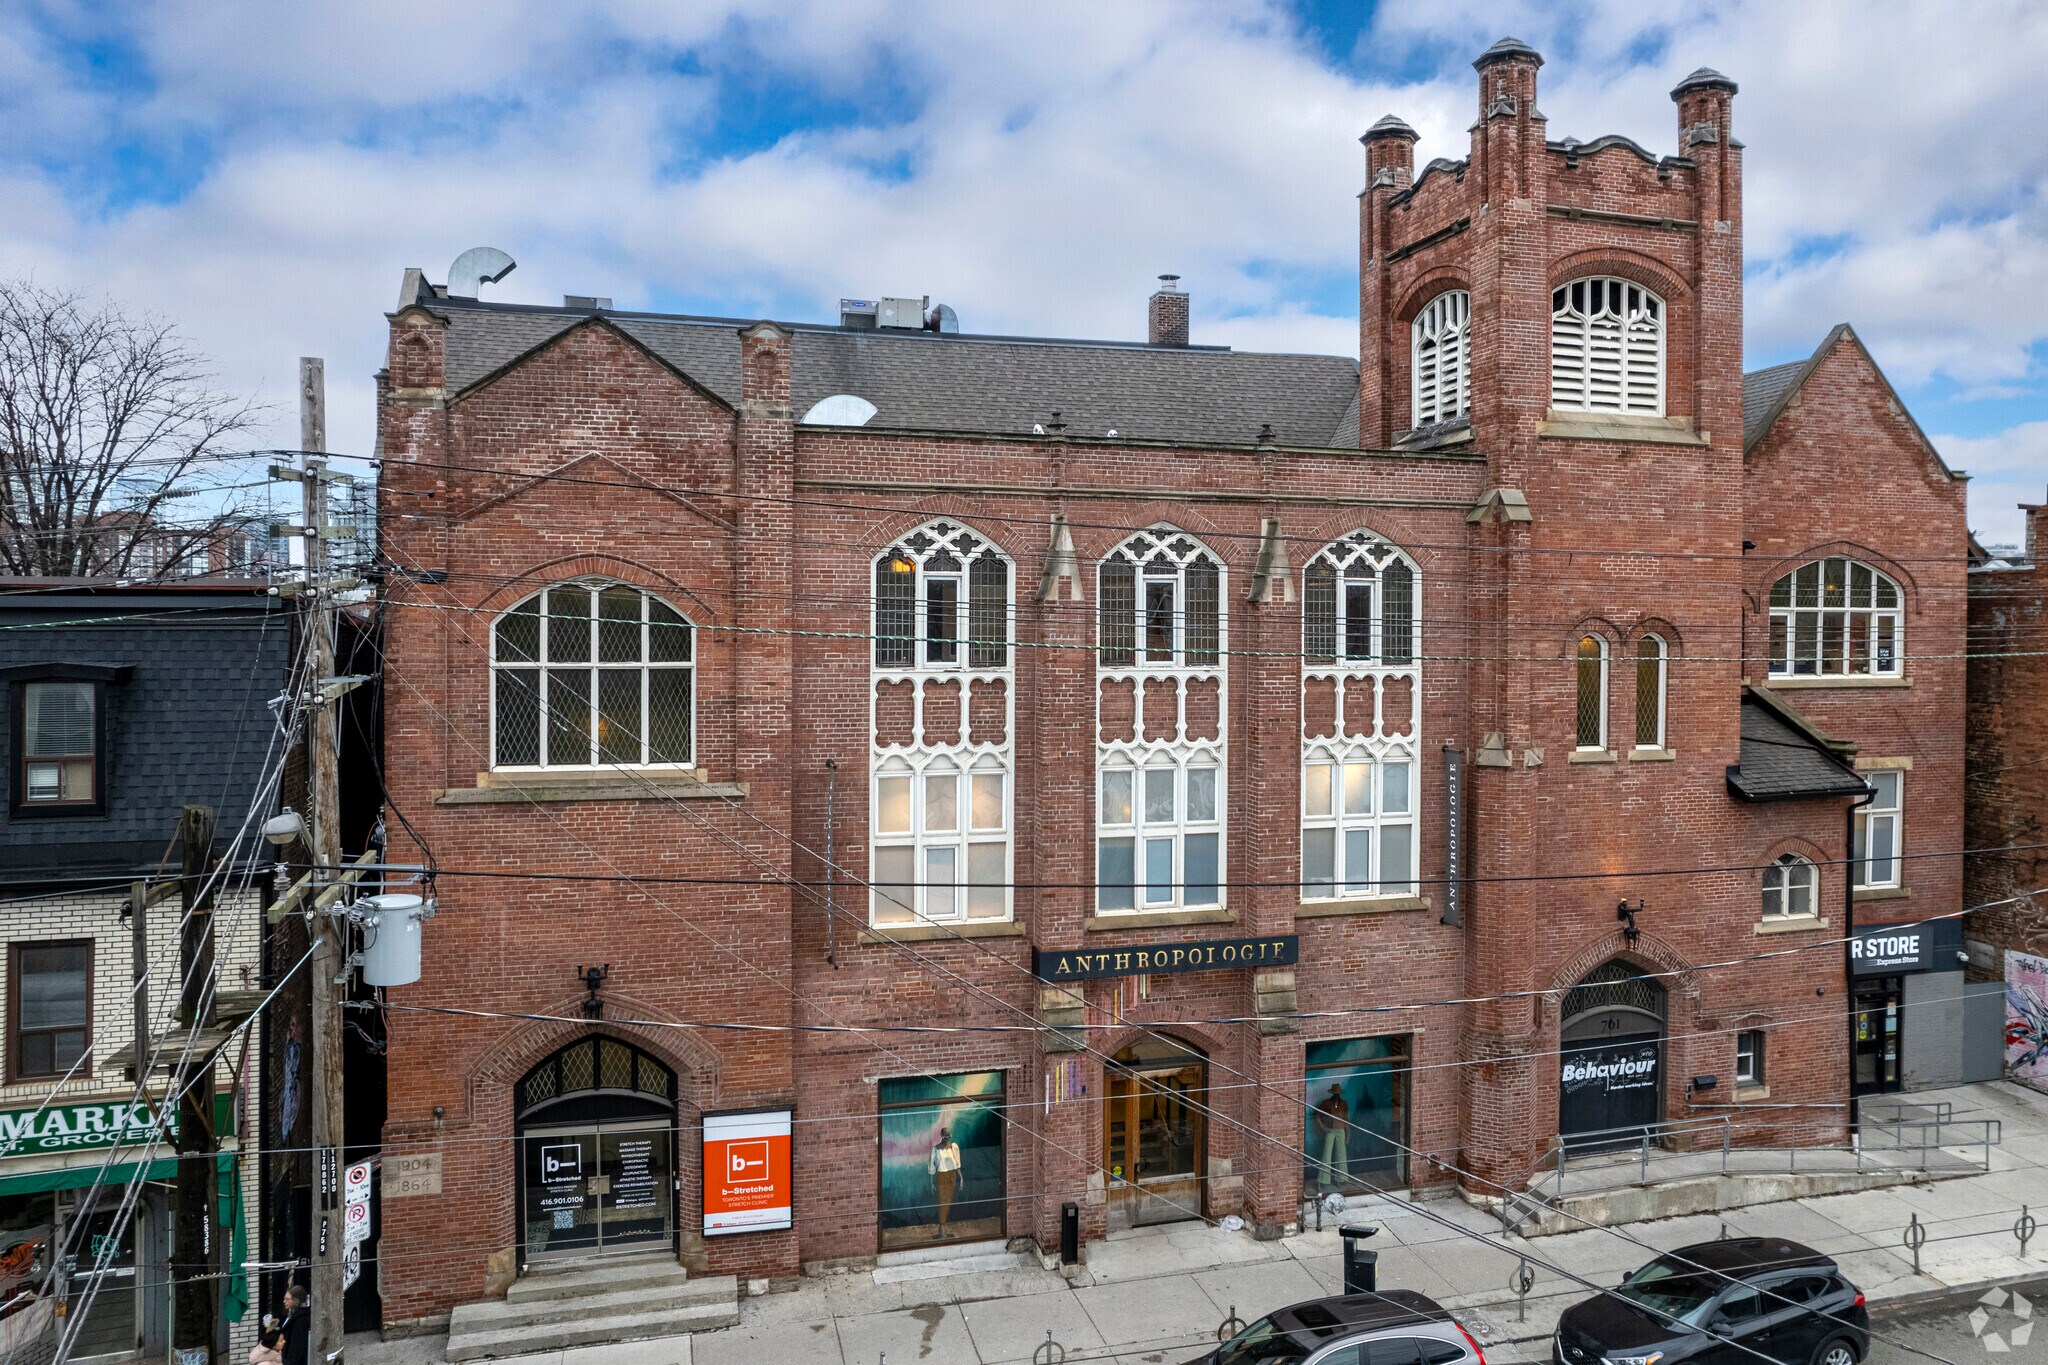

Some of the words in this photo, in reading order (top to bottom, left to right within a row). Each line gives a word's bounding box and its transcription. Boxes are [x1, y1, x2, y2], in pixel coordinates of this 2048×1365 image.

[1055, 942, 1285, 974] ANTHROPOLOGIE
[1852, 940, 1863, 958] R
[1866, 935, 1920, 957] STORE
[1877, 958, 1902, 966] Express
[1562, 1057, 1656, 1081] Behaviour
[0, 1100, 180, 1140] MARKE
[540, 1196, 584, 1205] 416.901.0106
